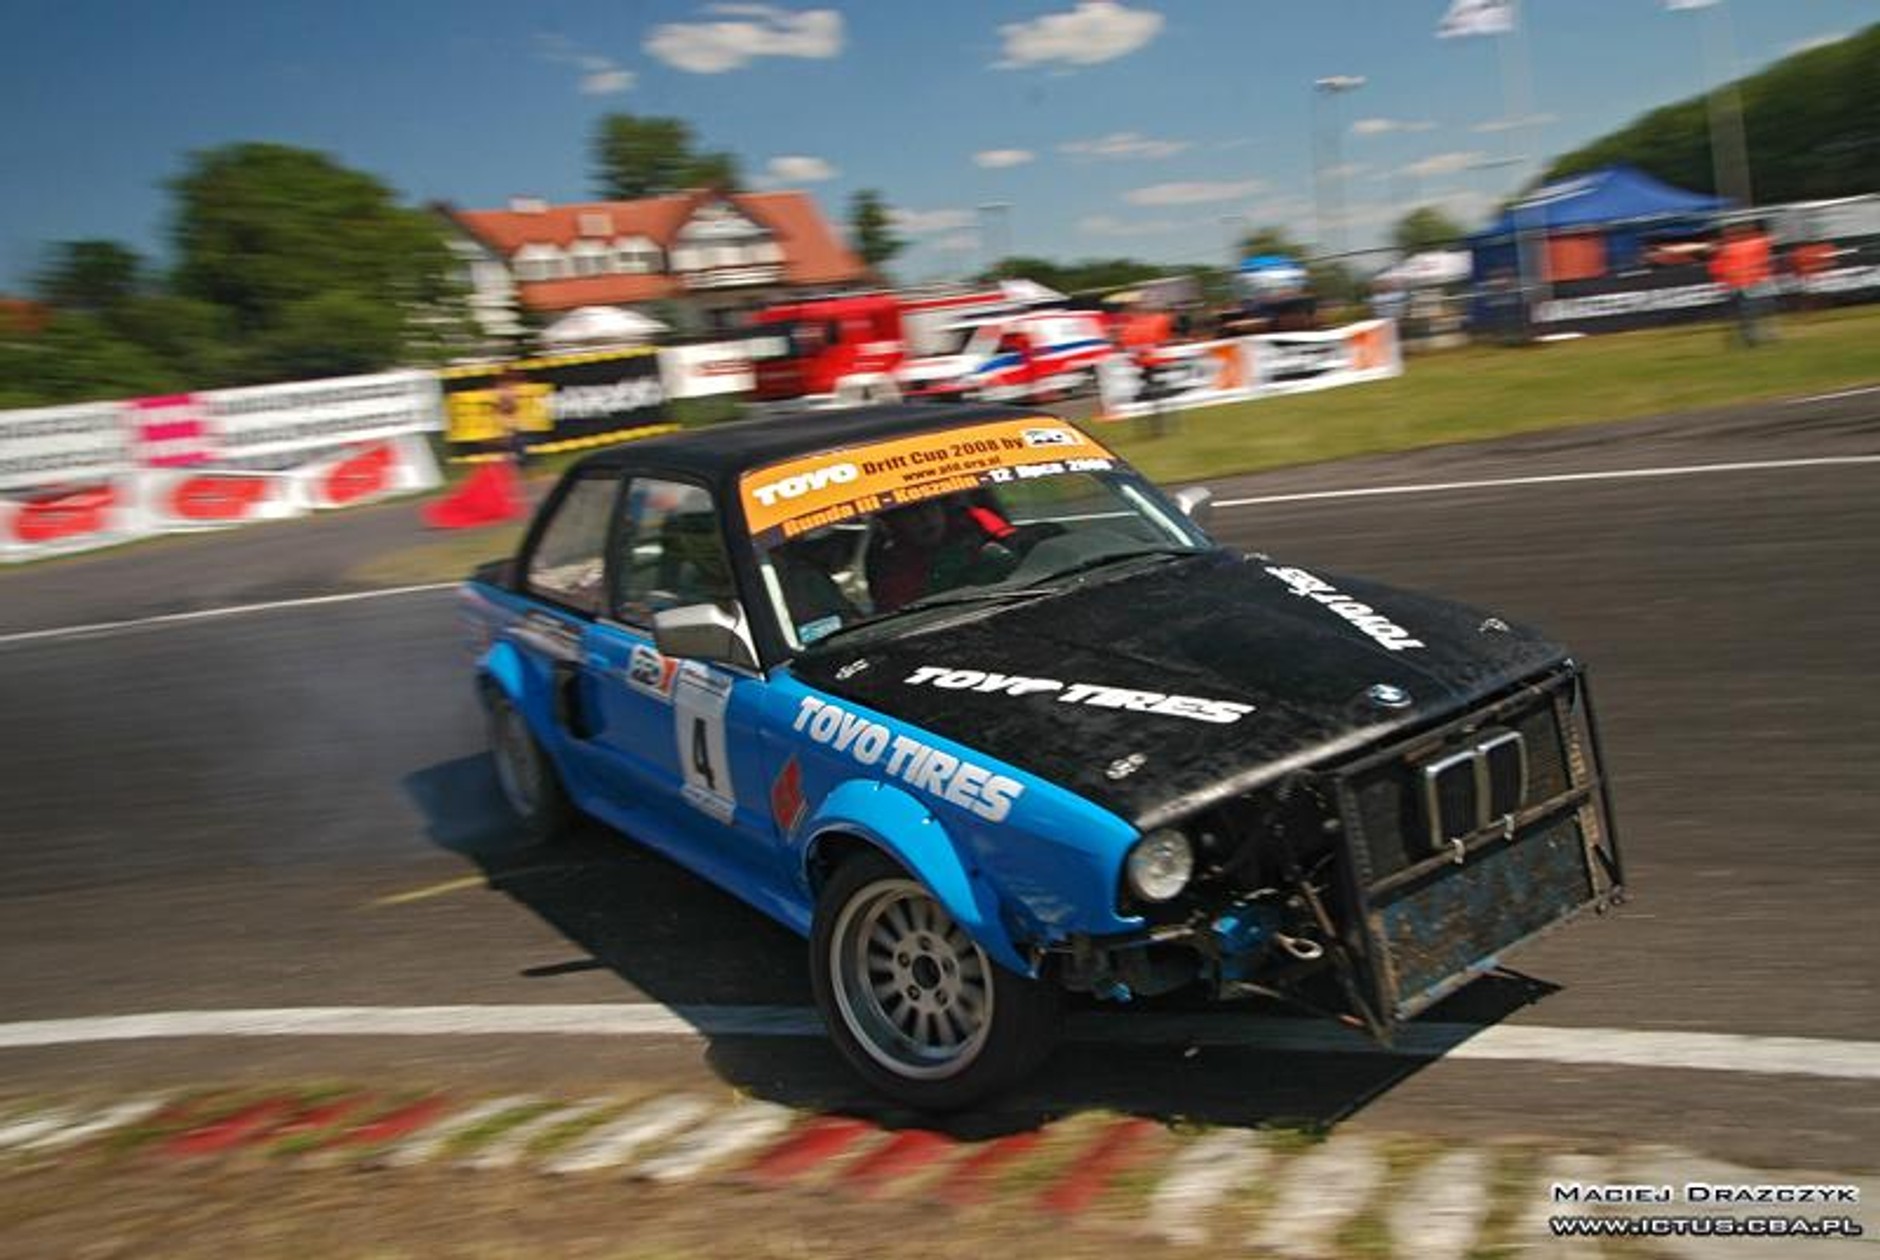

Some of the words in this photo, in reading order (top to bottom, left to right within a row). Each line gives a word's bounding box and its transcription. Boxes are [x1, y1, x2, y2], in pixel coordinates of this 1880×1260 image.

[752, 463, 859, 506] TOYO
[862, 456, 907, 475] Drift
[910, 447, 949, 465] Cup
[951, 439, 1001, 457] 2008
[1003, 437, 1025, 452] by
[783, 503, 854, 538] Runda
[892, 474, 980, 504] Koszalin
[988, 467, 1014, 484] 12
[1057, 683, 1256, 724] TIRES
[692, 716, 717, 791] 4
[792, 695, 892, 766] TOYO
[885, 734, 1026, 814] TIRES
